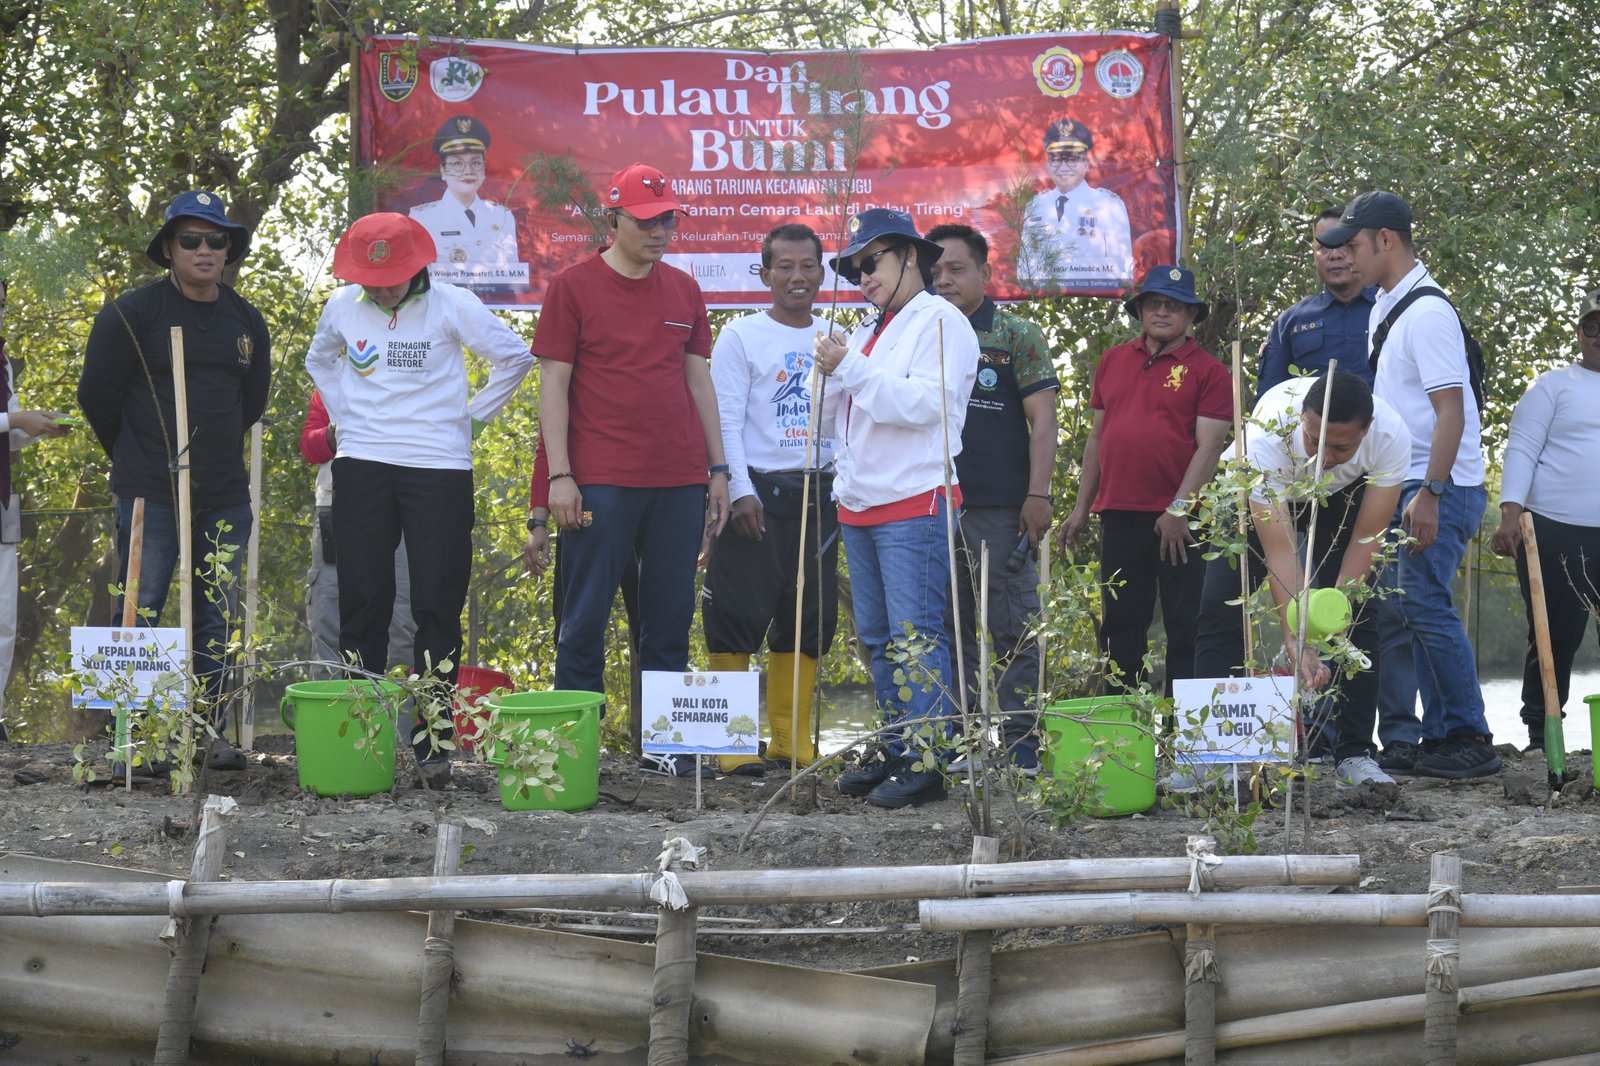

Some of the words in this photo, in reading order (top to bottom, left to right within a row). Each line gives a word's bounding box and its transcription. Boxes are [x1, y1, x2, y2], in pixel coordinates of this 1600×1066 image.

[582, 79, 751, 116] Pulau
[767, 80, 951, 130] Tirang
[728, 119, 808, 138] UNTUK
[690, 127, 848, 172] Bumi
[671, 178, 711, 195] ARANG
[715, 178, 763, 194] TARUNA
[765, 178, 837, 194] KECAMATAN
[680, 204, 737, 216] Tanam
[740, 203, 800, 216] Cemara
[806, 203, 841, 216] Laut
[846, 202, 860, 215] di
[681, 231, 739, 242] Kelurahan
[388, 341, 431, 350] REIMAGINE
[387, 350, 427, 359] RECREATE
[387, 359, 423, 368] RESTORE
[98, 646, 136, 658] KEPALA
[672, 697, 699, 709] WALI
[701, 698, 729, 710] KOTA
[671, 711, 728, 723] SEMARANG
[1211, 703, 1257, 718] CAMAT
